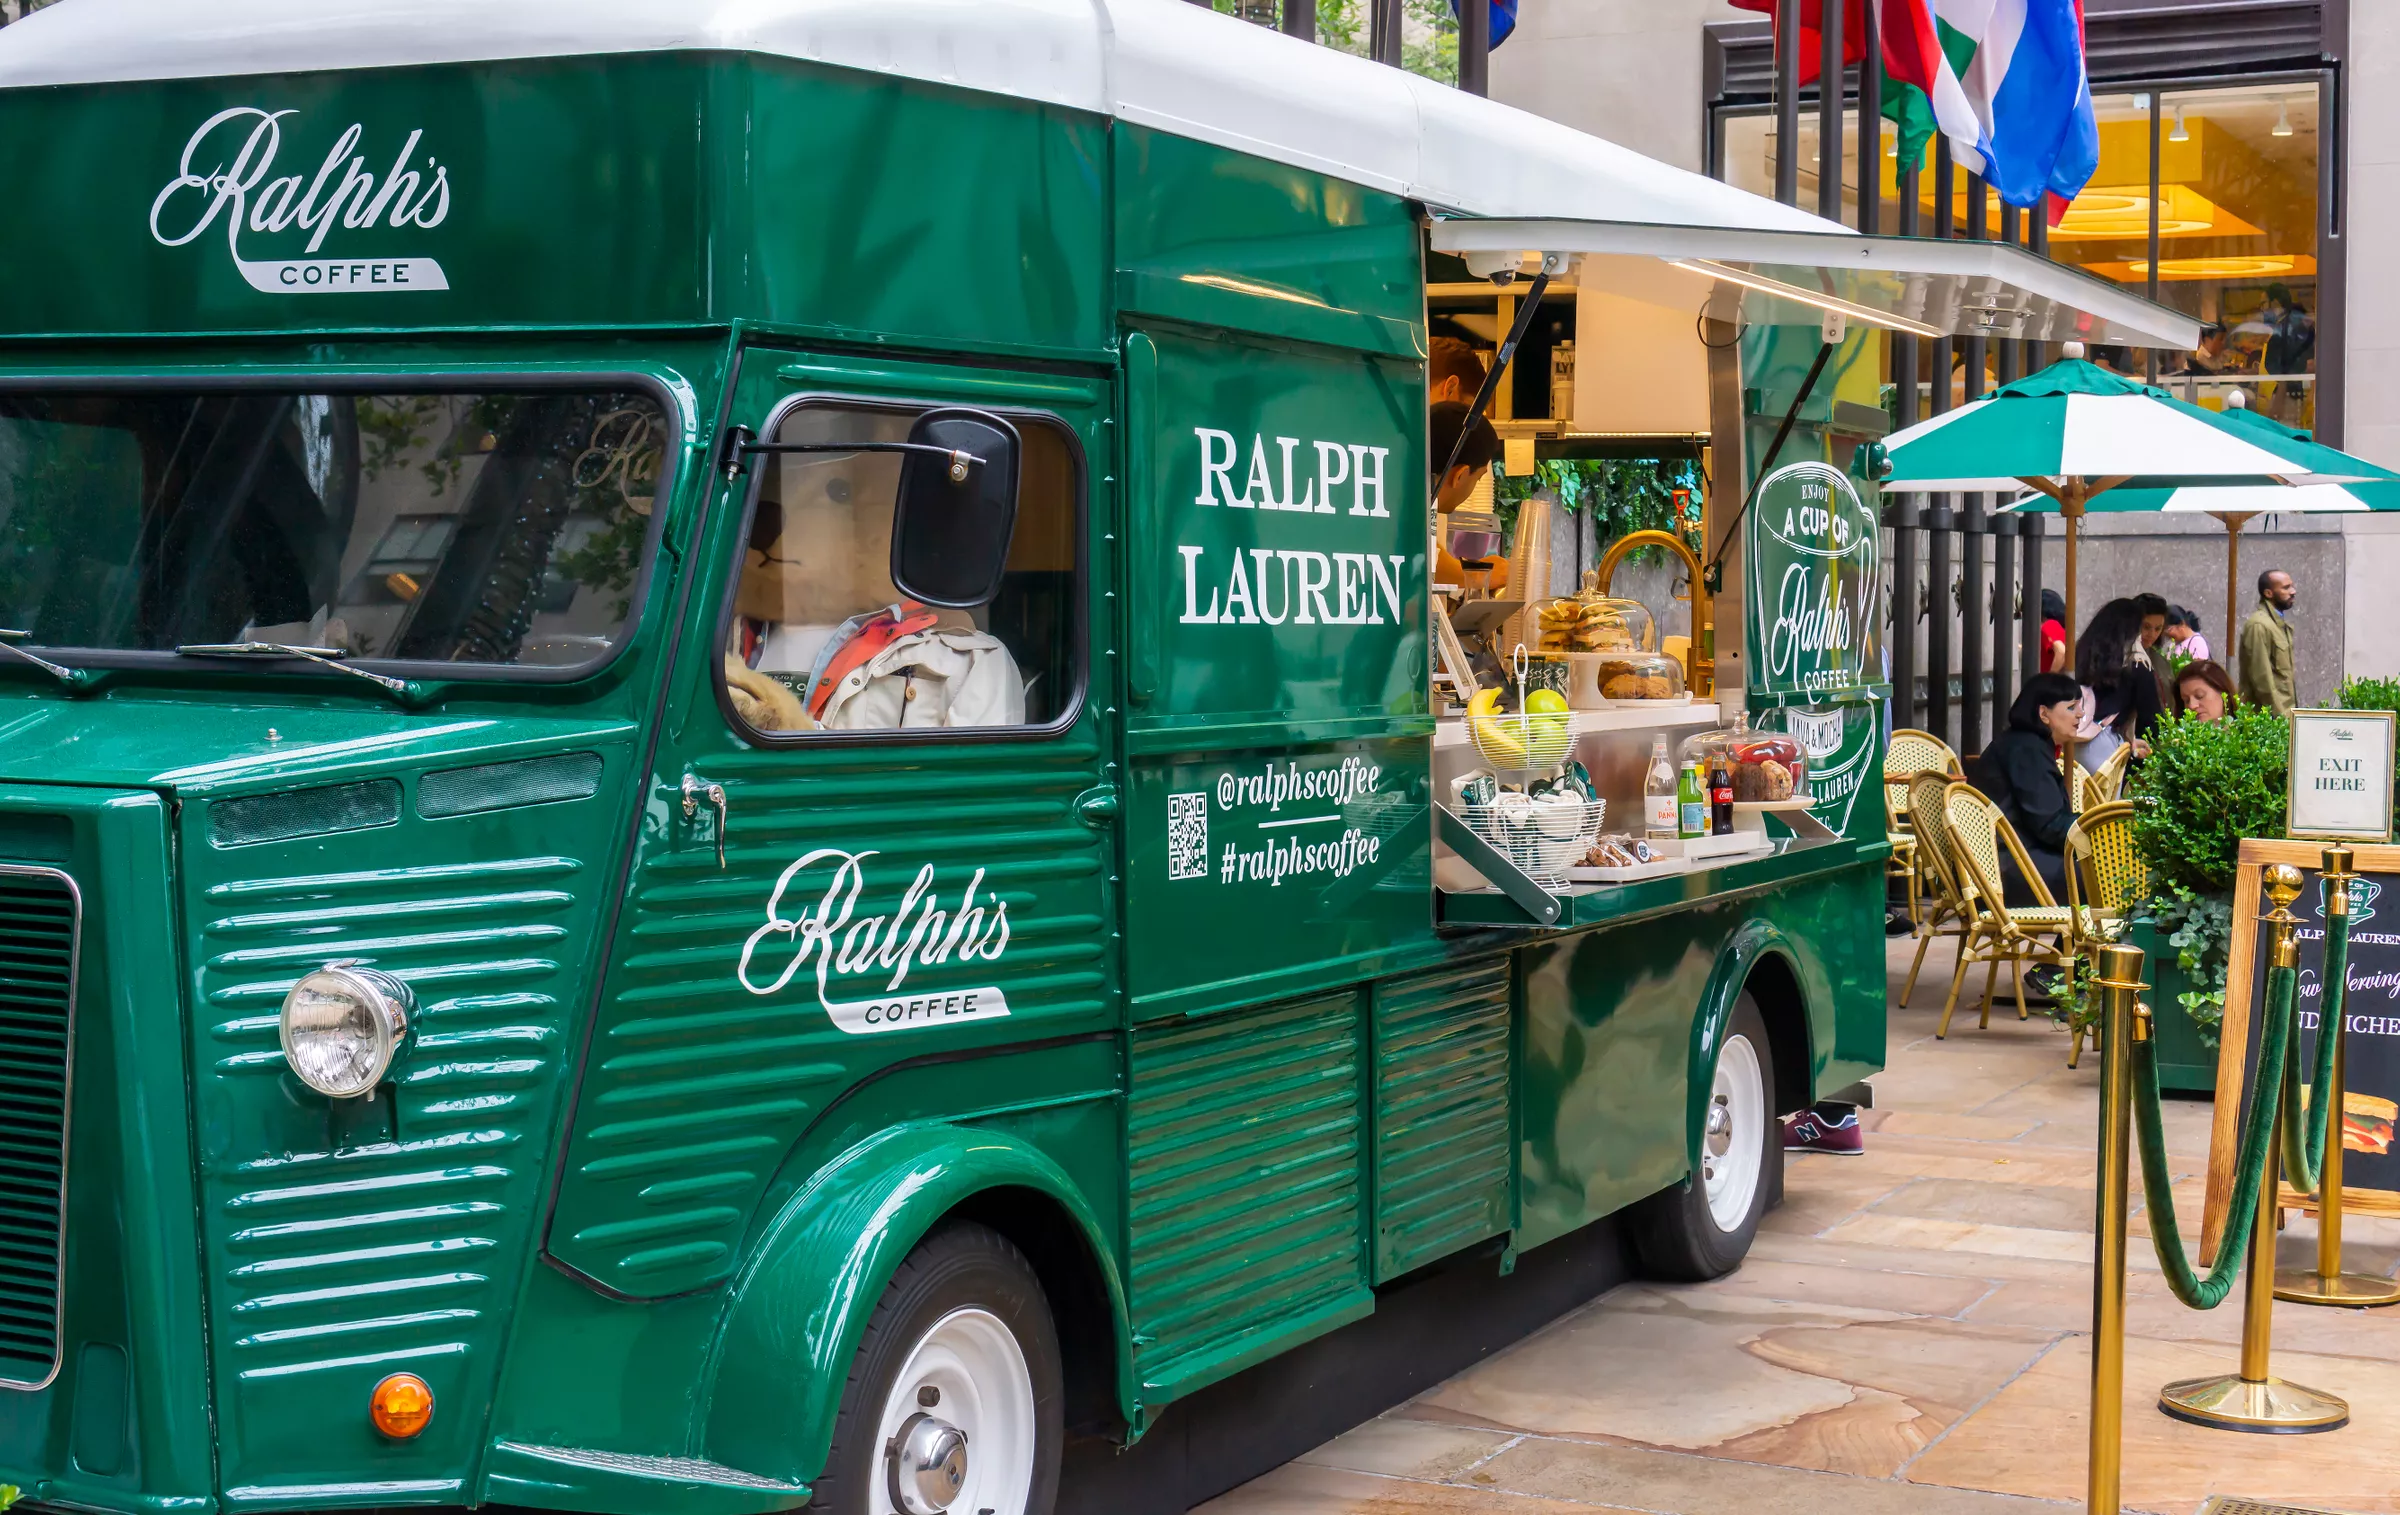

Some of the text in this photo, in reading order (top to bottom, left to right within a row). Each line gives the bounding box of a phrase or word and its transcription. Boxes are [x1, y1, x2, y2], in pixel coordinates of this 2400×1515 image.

[150, 107, 450, 254] Ralph's
[280, 264, 409, 285] COFFEE
[1194, 427, 1390, 518] RALPH
[1801, 484, 1829, 502] ENJOY
[1783, 506, 1849, 547] A CUP OF
[1178, 545, 1406, 625] LAUREN
[1771, 562, 1851, 680] Ralph's
[1804, 669, 1850, 690] COFFEE
[1792, 716, 1842, 751] JAVA & MOCHA
[2319, 758, 2363, 771] EXIT
[1217, 756, 1379, 812] @ralphscoffee
[1818, 770, 1854, 804] LAUREN
[2315, 777, 2366, 791] HERE
[1220, 828, 1380, 887] #ralphscoffee
[737, 848, 1010, 992] Ralph's
[2294, 928, 2325, 940] ALP
[865, 994, 978, 1025] COFFEE
[1794, 1122, 1821, 1142] N
